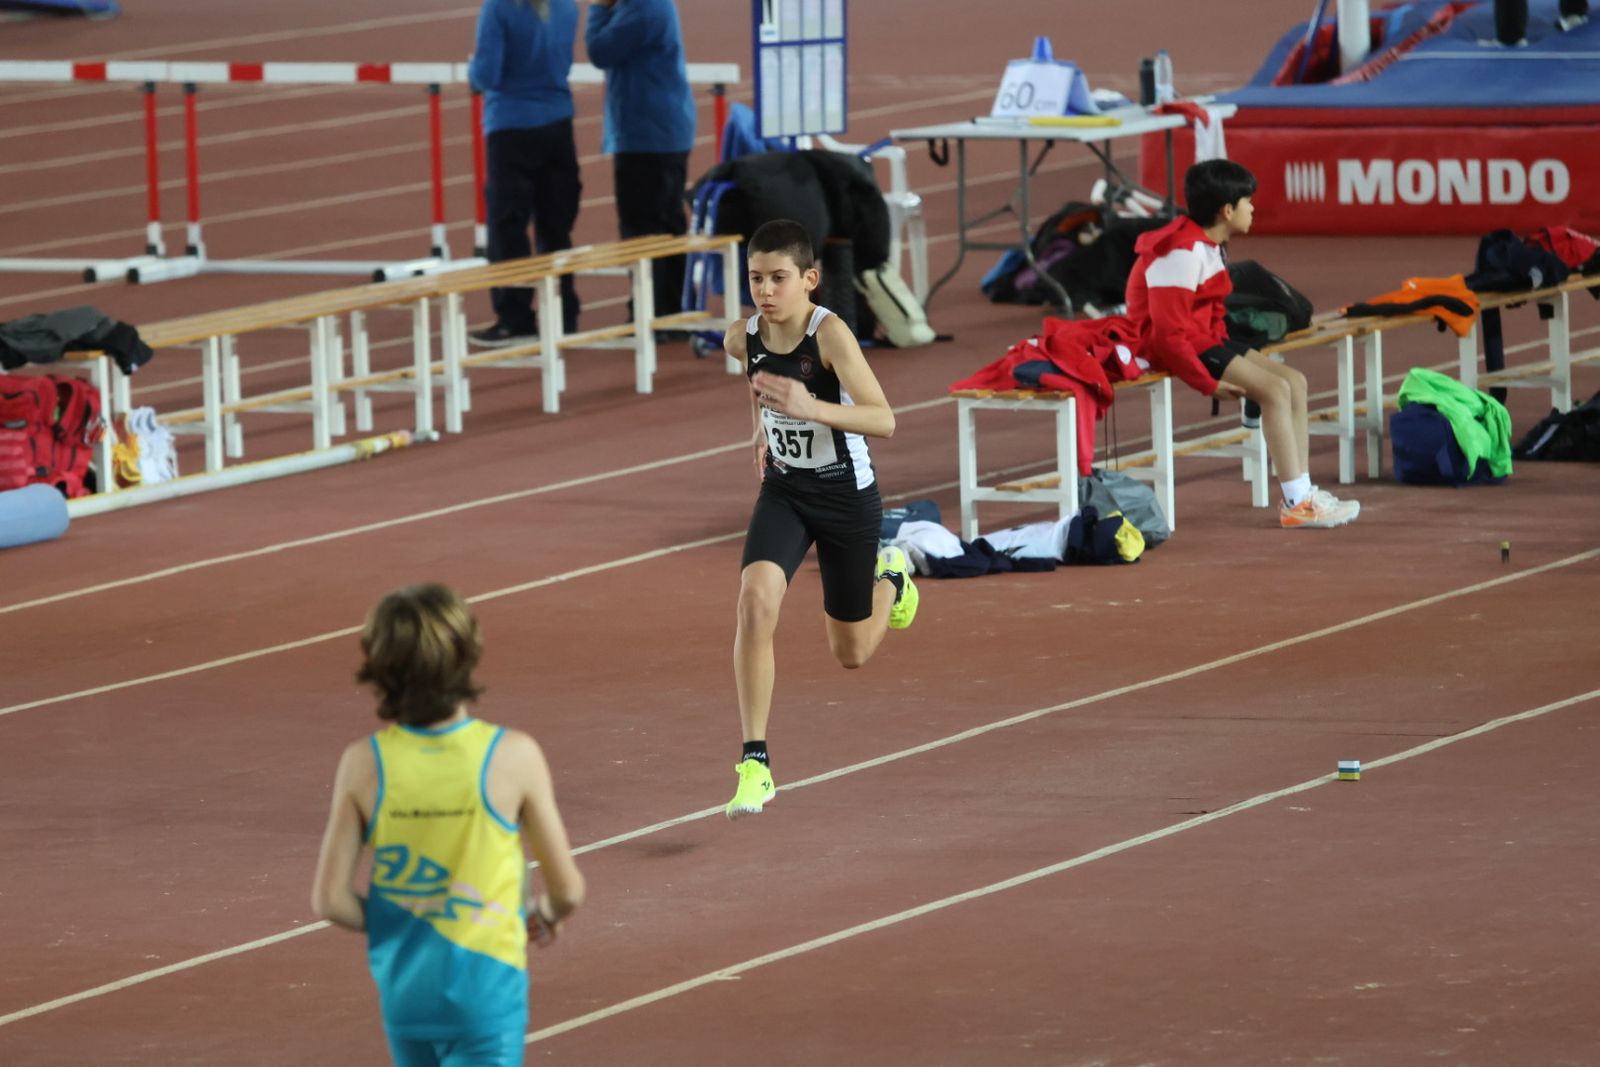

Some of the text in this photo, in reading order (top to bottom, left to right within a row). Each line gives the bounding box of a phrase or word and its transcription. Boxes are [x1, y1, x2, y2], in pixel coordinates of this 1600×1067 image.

[1000, 81, 1035, 110] 60
[1337, 158, 1571, 205] MONDO
[772, 427, 814, 459] 357
